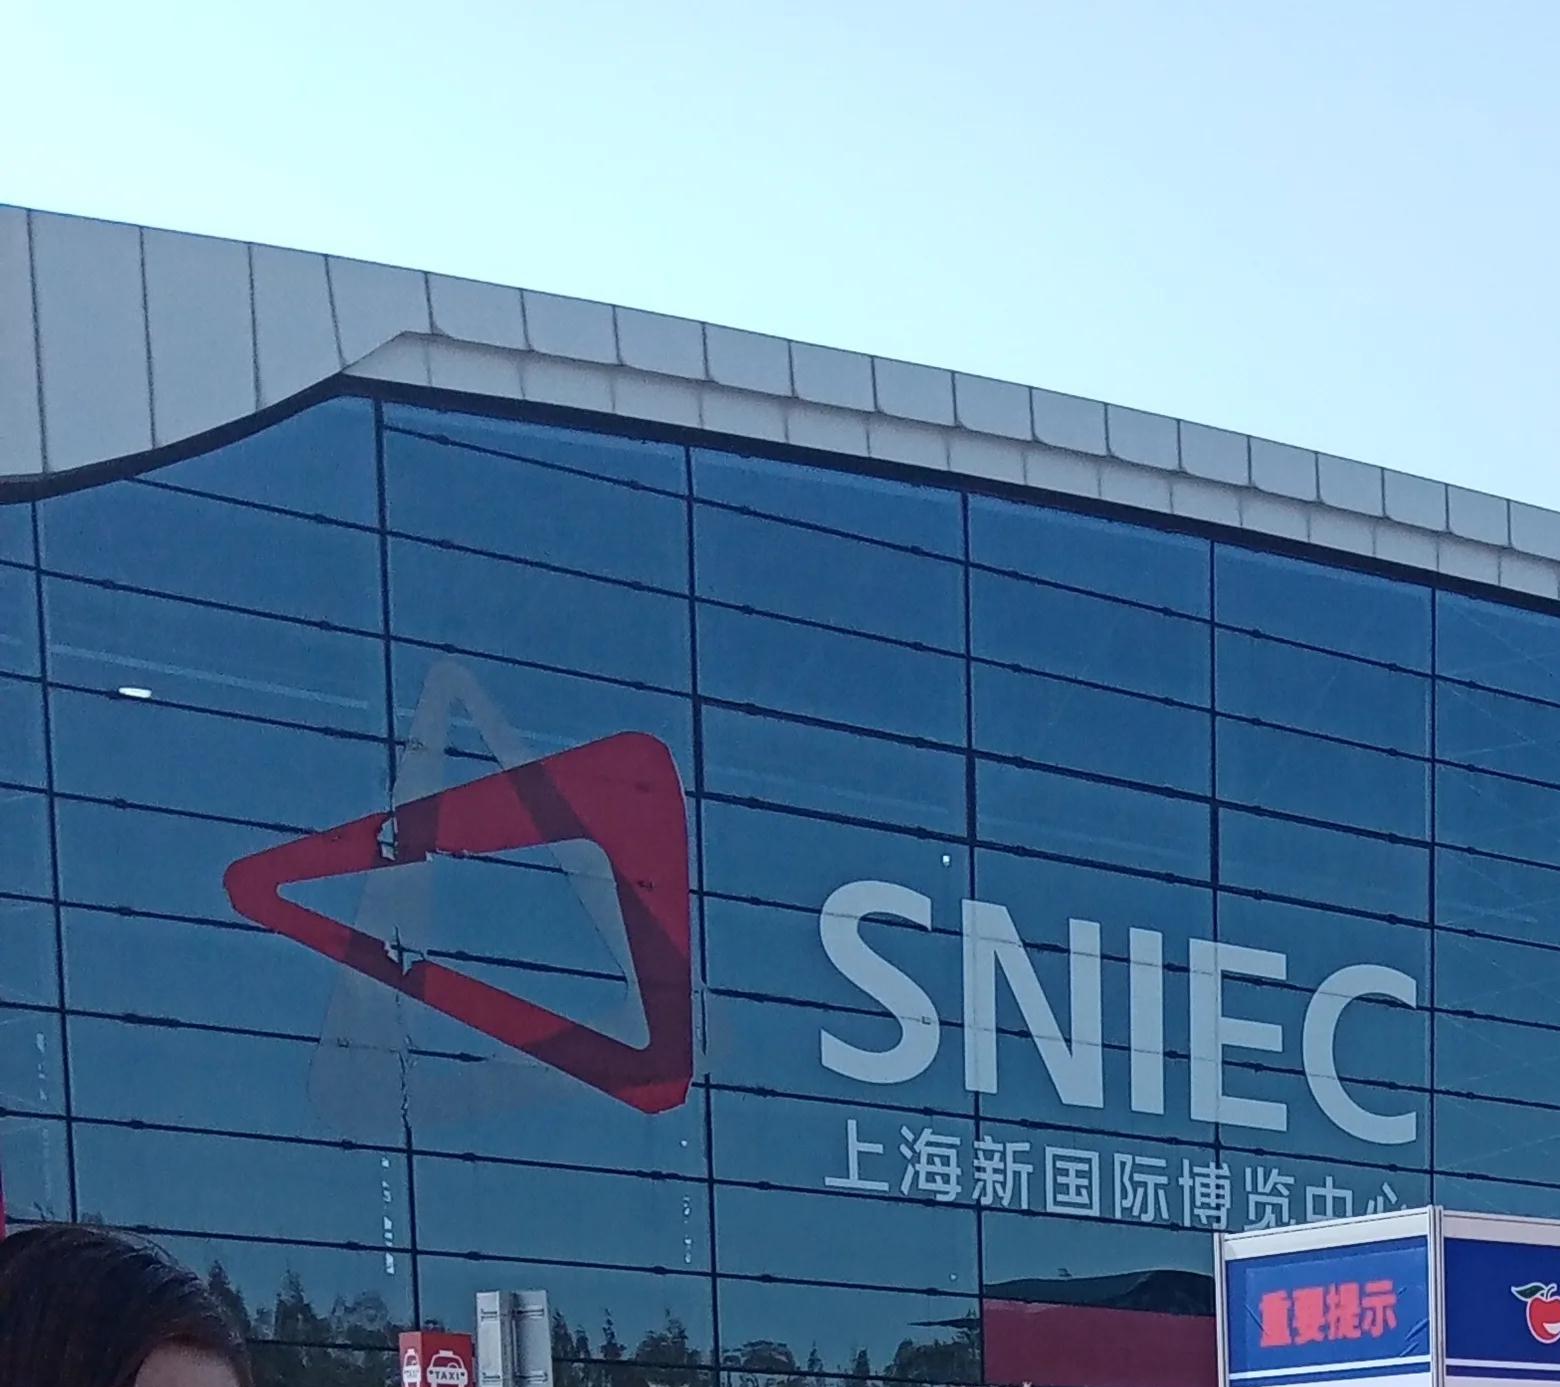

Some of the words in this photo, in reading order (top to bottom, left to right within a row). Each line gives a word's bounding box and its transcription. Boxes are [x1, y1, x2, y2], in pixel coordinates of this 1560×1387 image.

[819, 880, 1417, 1144] SNIEC
[1259, 1280, 1398, 1348] 重要提示
[435, 1370, 461, 1381] TAXI
